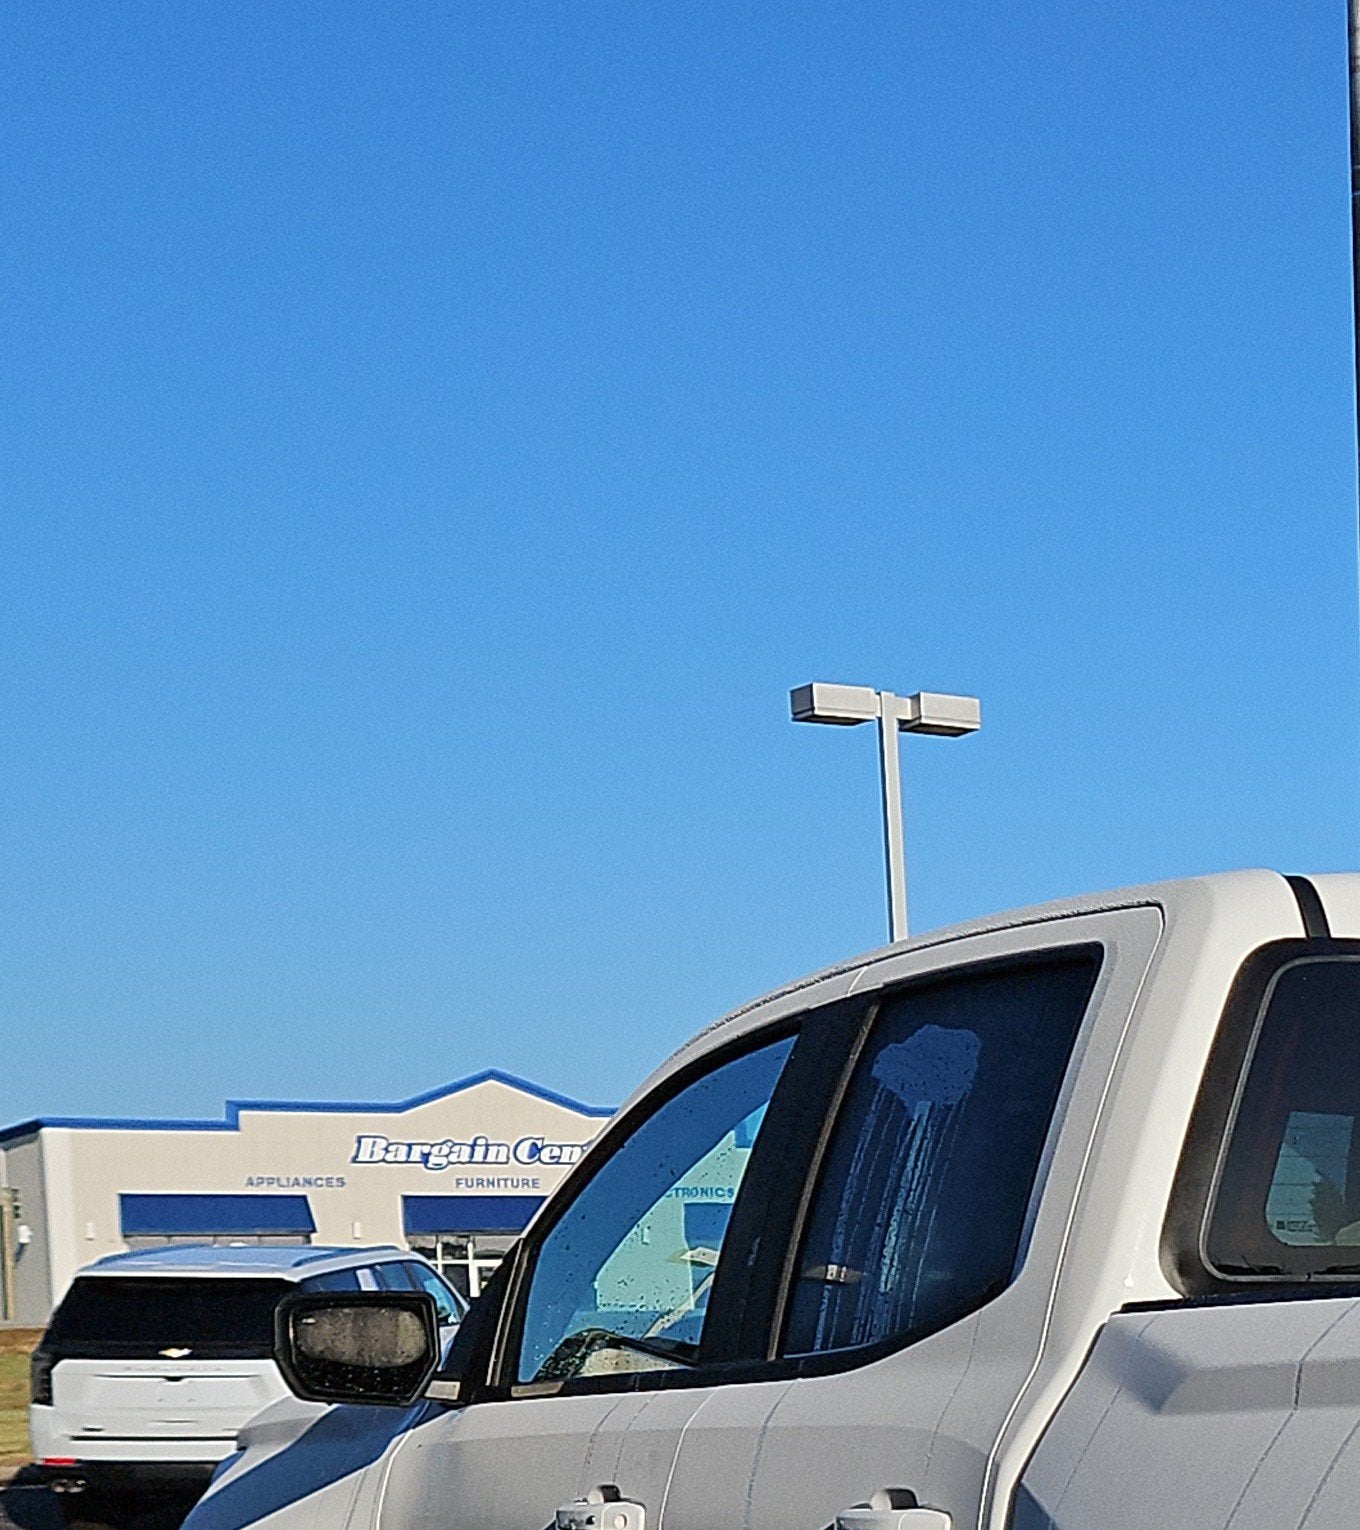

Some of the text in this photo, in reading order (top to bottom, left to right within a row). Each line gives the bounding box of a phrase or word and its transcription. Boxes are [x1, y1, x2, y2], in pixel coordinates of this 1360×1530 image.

[351, 1135, 588, 1171] Bargain Cen
[245, 1176, 346, 1188] APPLIANCES
[455, 1177, 540, 1189] FURNITURE
